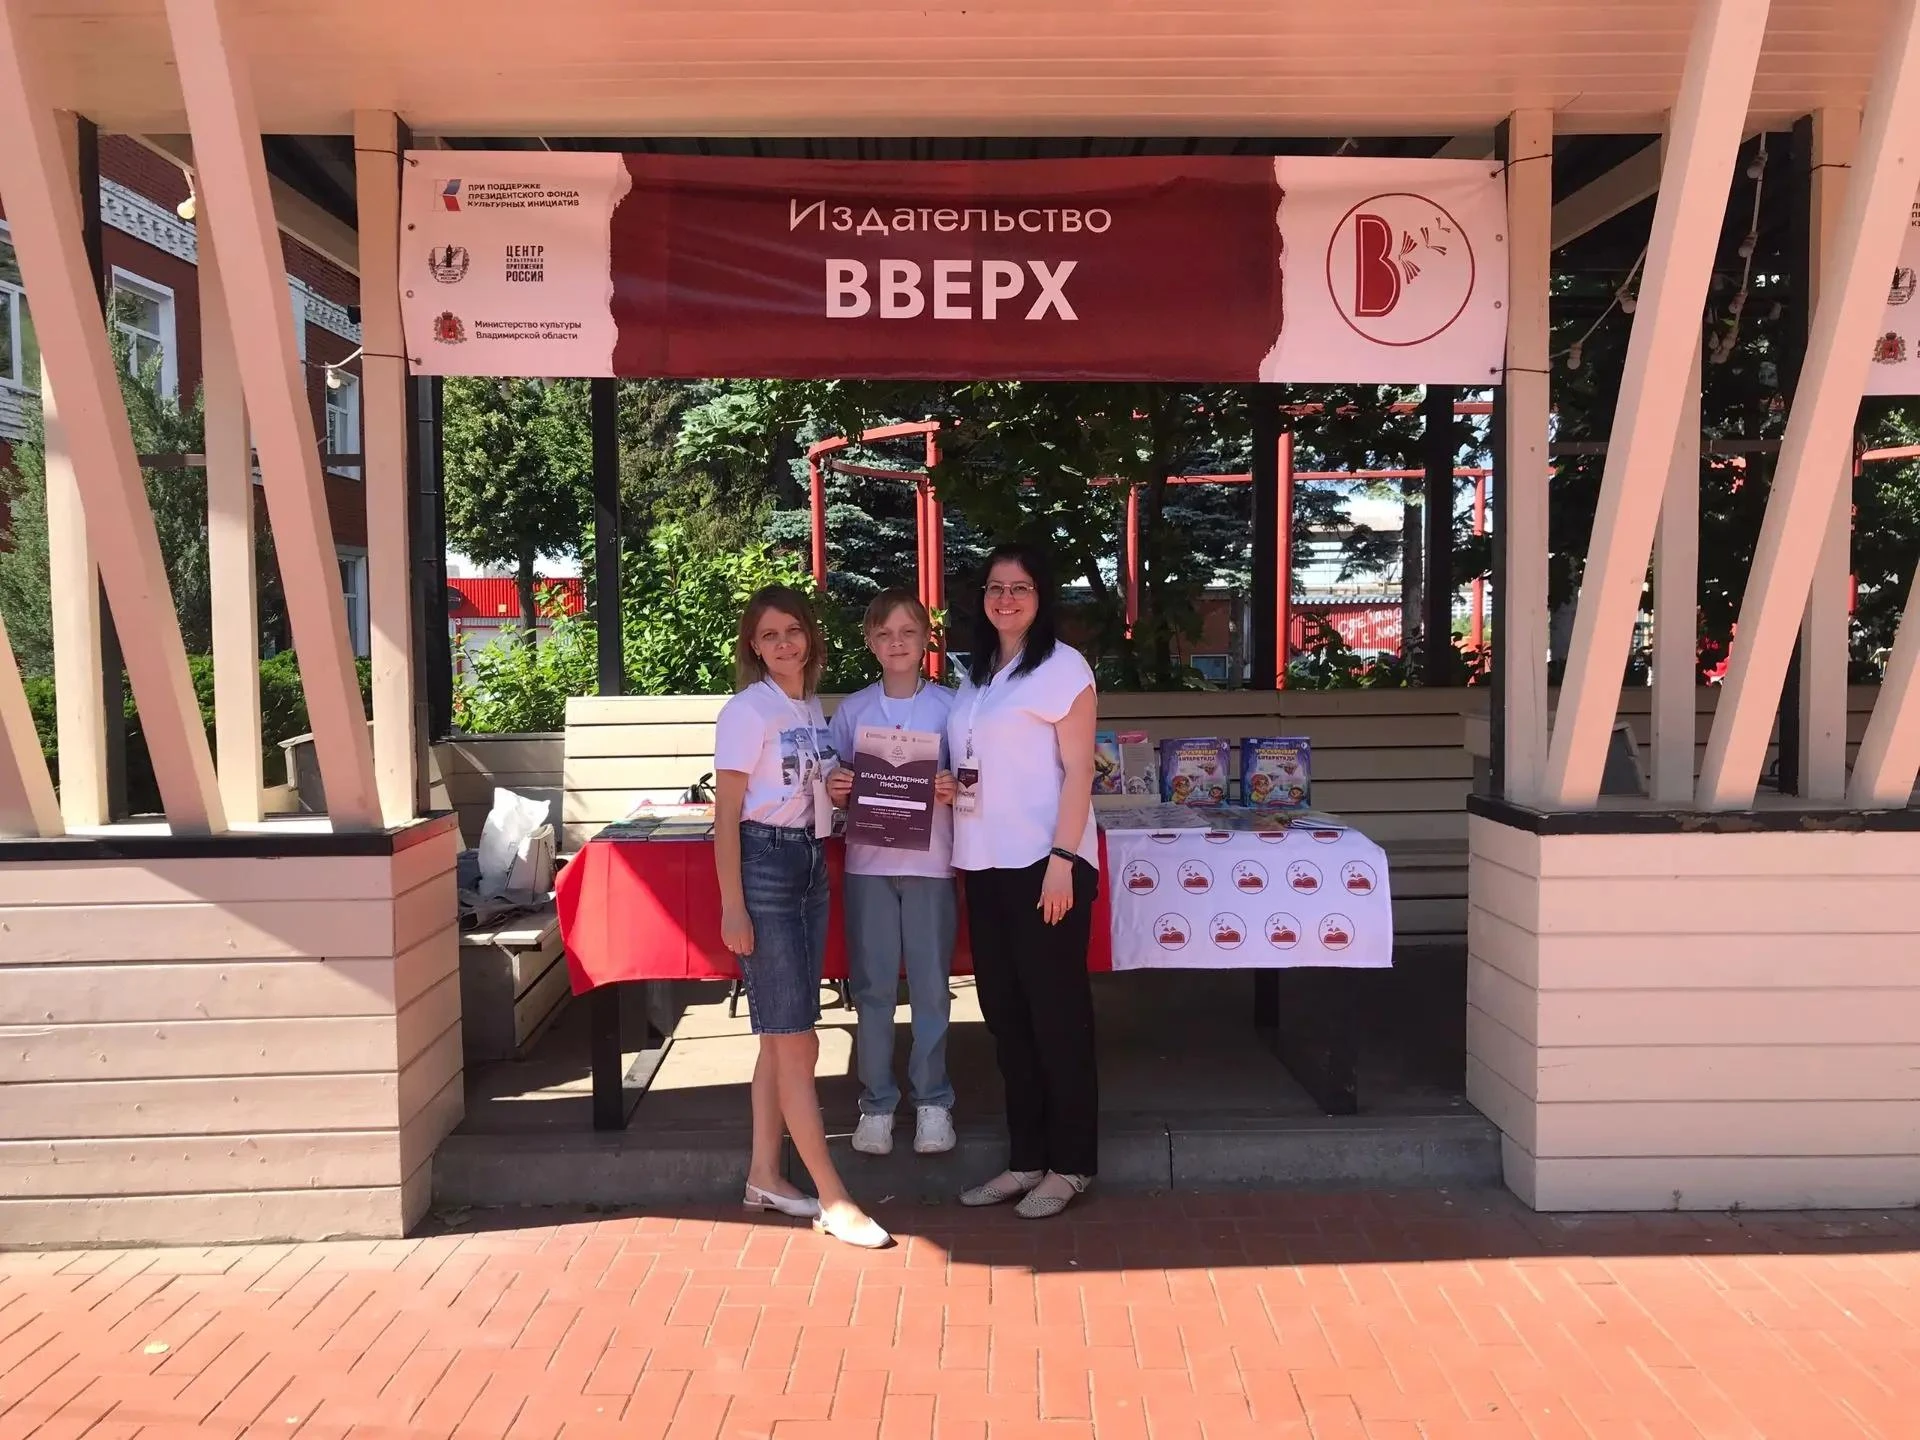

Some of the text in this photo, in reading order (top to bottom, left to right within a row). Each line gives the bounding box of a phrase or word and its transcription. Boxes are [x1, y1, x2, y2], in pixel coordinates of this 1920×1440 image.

[487, 183, 541, 191] ПОДДЕРЖКЕ
[468, 192, 544, 200] ПРЕЗИДЕНТСКОГО
[528, 200, 580, 208] ИНИЦИАТИВ
[790, 199, 1112, 236] Издательство
[506, 245, 544, 257] ЦЕНТР
[506, 271, 544, 282] РОССИЯ
[825, 258, 1080, 321] ВВЕРХ
[474, 320, 582, 330] Министерство культуры
[476, 331, 578, 340] Владимирской области
[860, 772, 929, 785] БЛАГОДАРСТВЕННОЕ
[880, 781, 909, 790] ПИСЬМО
